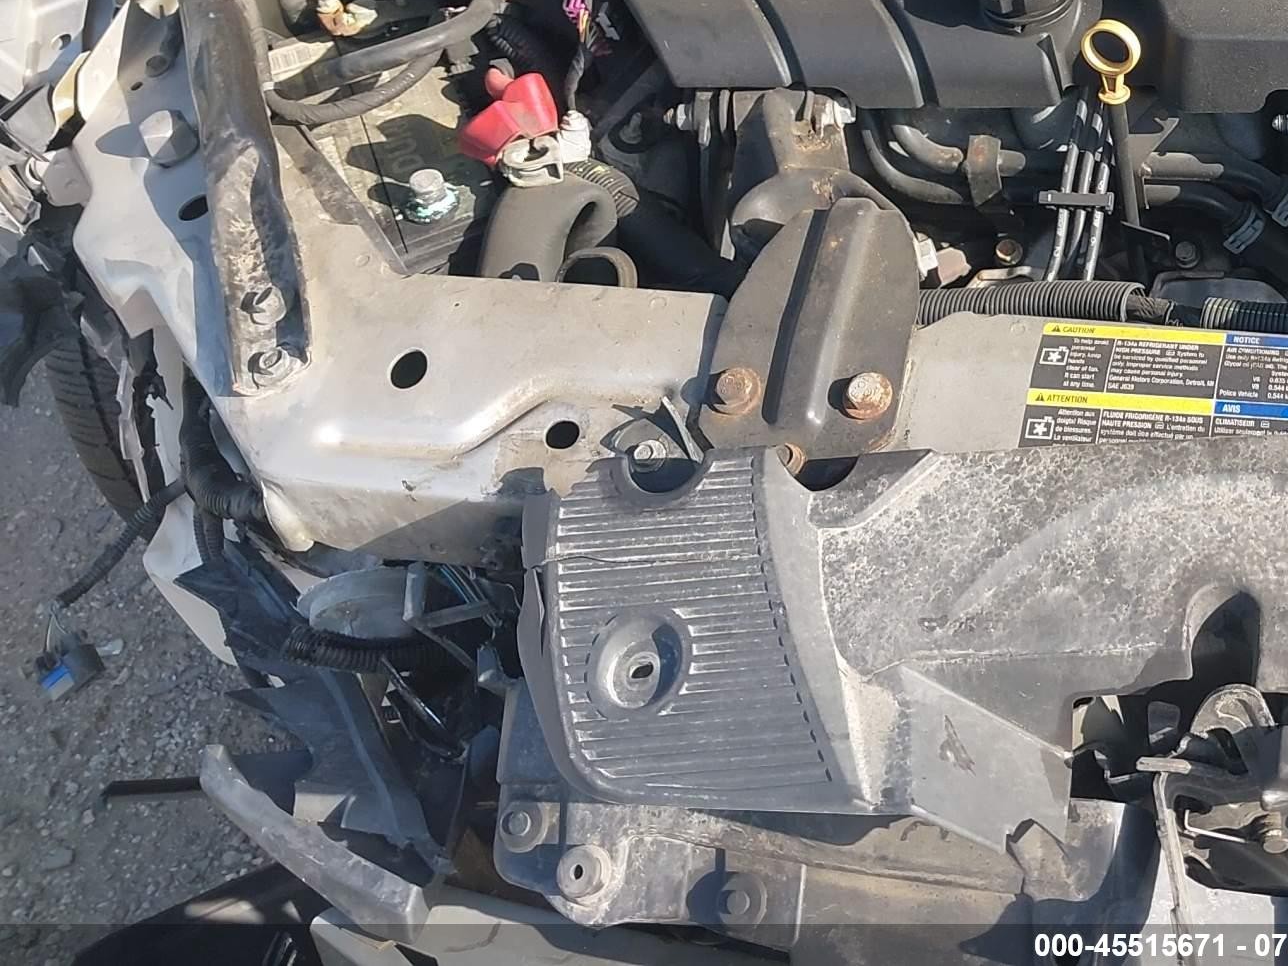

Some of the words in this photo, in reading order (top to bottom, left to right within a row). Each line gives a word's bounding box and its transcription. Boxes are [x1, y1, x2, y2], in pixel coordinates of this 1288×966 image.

[1233, 336, 1260, 344] NOTICE
[1047, 394, 1088, 403] ATTENTION
[1222, 404, 1240, 413] AVIS
